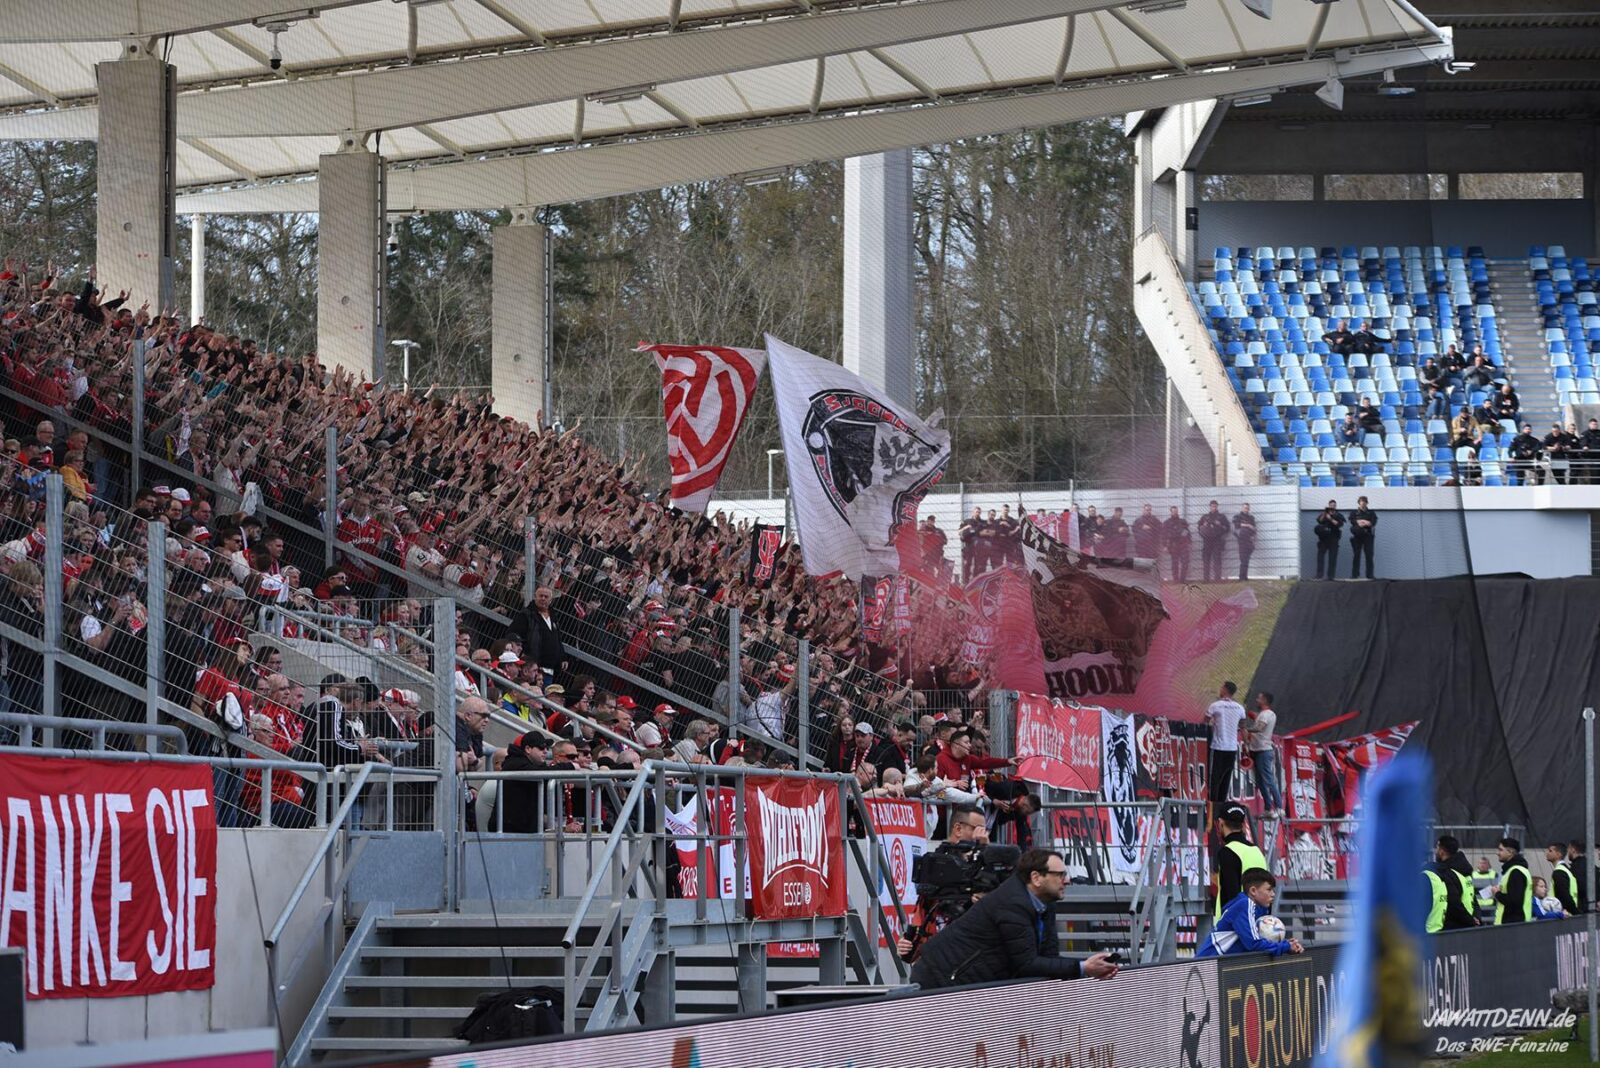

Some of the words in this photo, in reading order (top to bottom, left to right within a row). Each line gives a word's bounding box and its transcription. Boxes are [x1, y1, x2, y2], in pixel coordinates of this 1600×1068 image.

[871, 803, 916, 828] FANCLUB
[0, 793, 136, 995] ANKE
[146, 787, 210, 975] SIE
[1227, 977, 1312, 1068] FORUM
